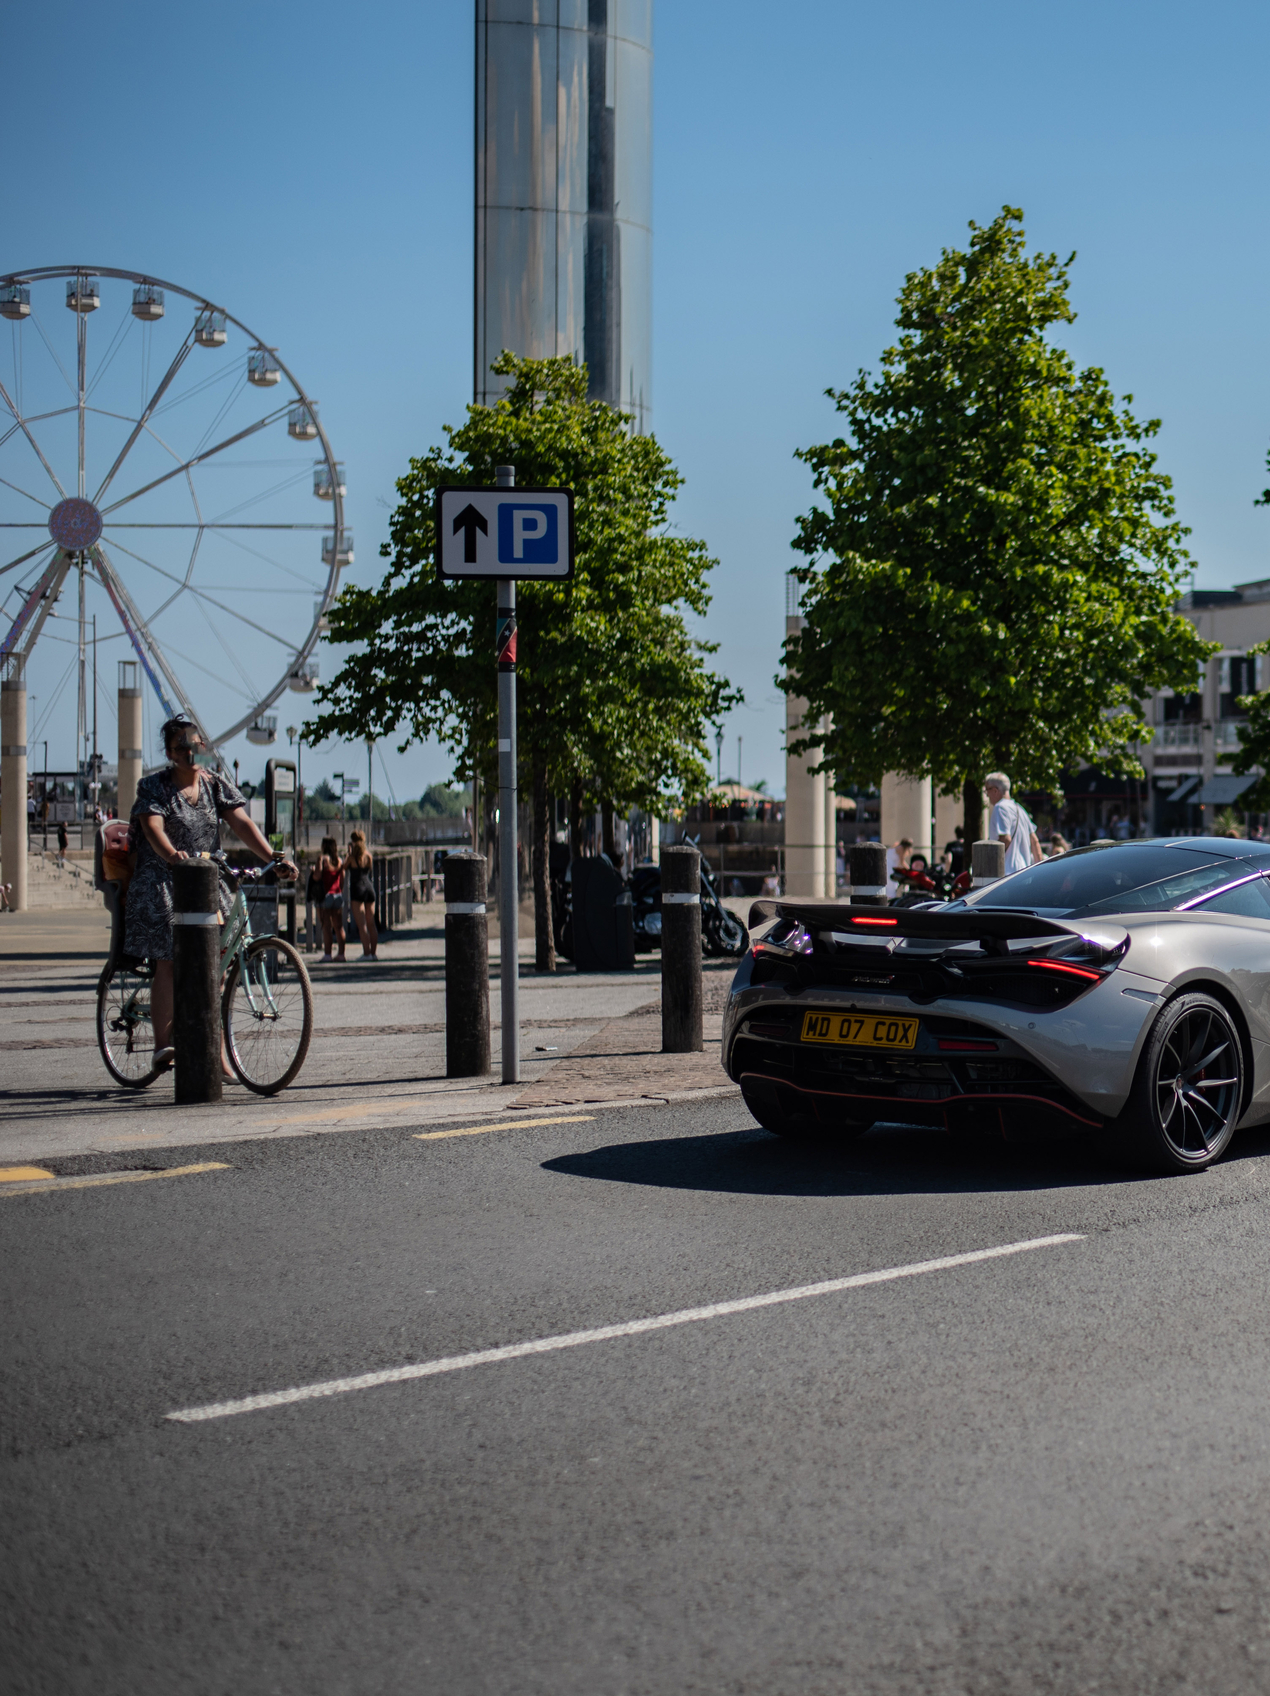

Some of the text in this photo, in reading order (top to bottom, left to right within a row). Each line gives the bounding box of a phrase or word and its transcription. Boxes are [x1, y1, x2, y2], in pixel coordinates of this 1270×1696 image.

[513, 509, 548, 559] P
[806, 1016, 913, 1044] MD 07 COX
